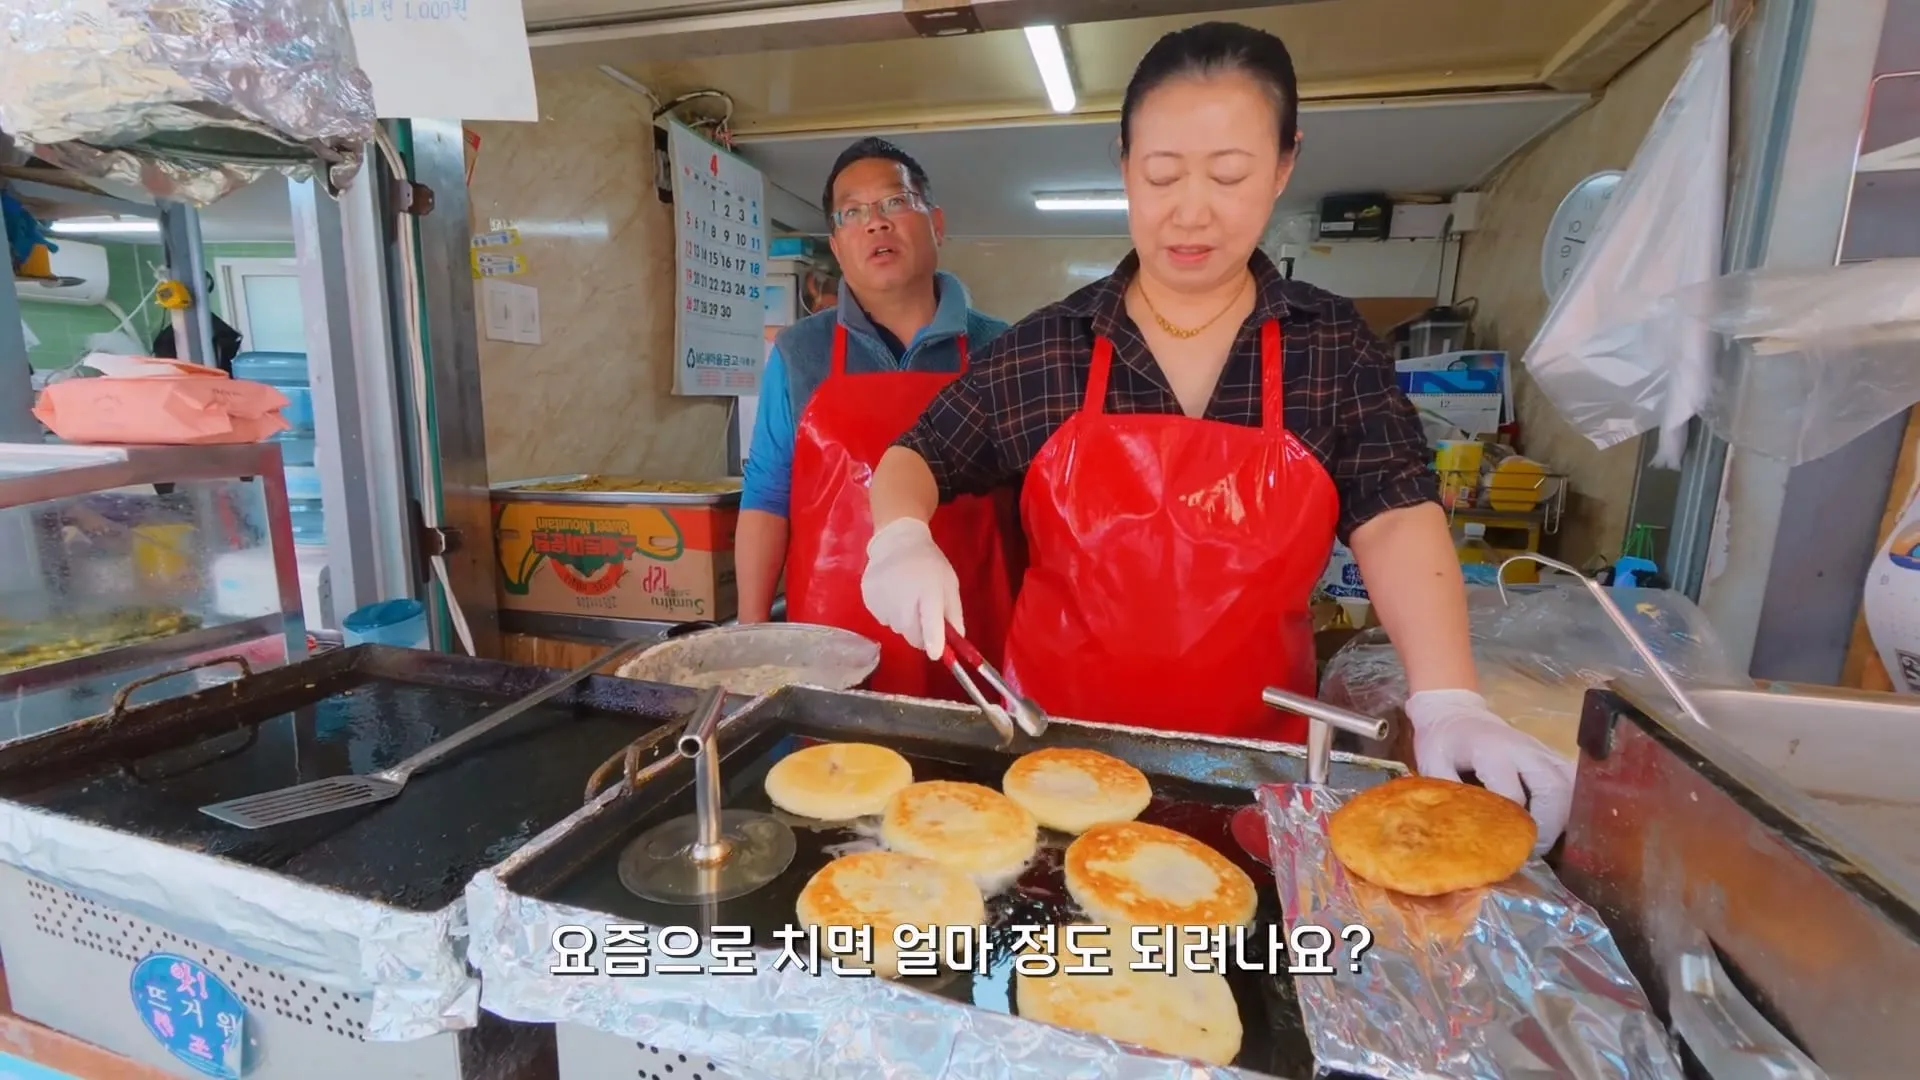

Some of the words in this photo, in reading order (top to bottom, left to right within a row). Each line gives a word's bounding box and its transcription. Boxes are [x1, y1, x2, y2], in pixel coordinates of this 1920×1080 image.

[709, 153, 719, 177] 4
[724, 204, 730, 217] 2
[738, 208, 745, 221] 3
[752, 213, 758, 225] 4
[686, 210, 691, 225] 5
[694, 216, 699, 229] 6
[711, 224, 717, 238] 8
[724, 229, 730, 242] 9
[736, 233, 746, 246] 10
[751, 237, 760, 250] 11
[1569, 220, 1582, 233] 10
[1560, 245, 1572, 258] 9
[709, 251, 718, 265] 15
[721, 256, 731, 269] 16
[735, 258, 746, 272] 17
[750, 262, 760, 275] 18
[709, 276, 718, 291] 22
[721, 279, 731, 294] 23
[735, 282, 746, 296] 24
[749, 285, 760, 299] 25
[709, 302, 718, 316] 29
[720, 304, 731, 318] 30
[537, 517, 592, 535] Mountain
[593, 519, 629, 535] Sweet
